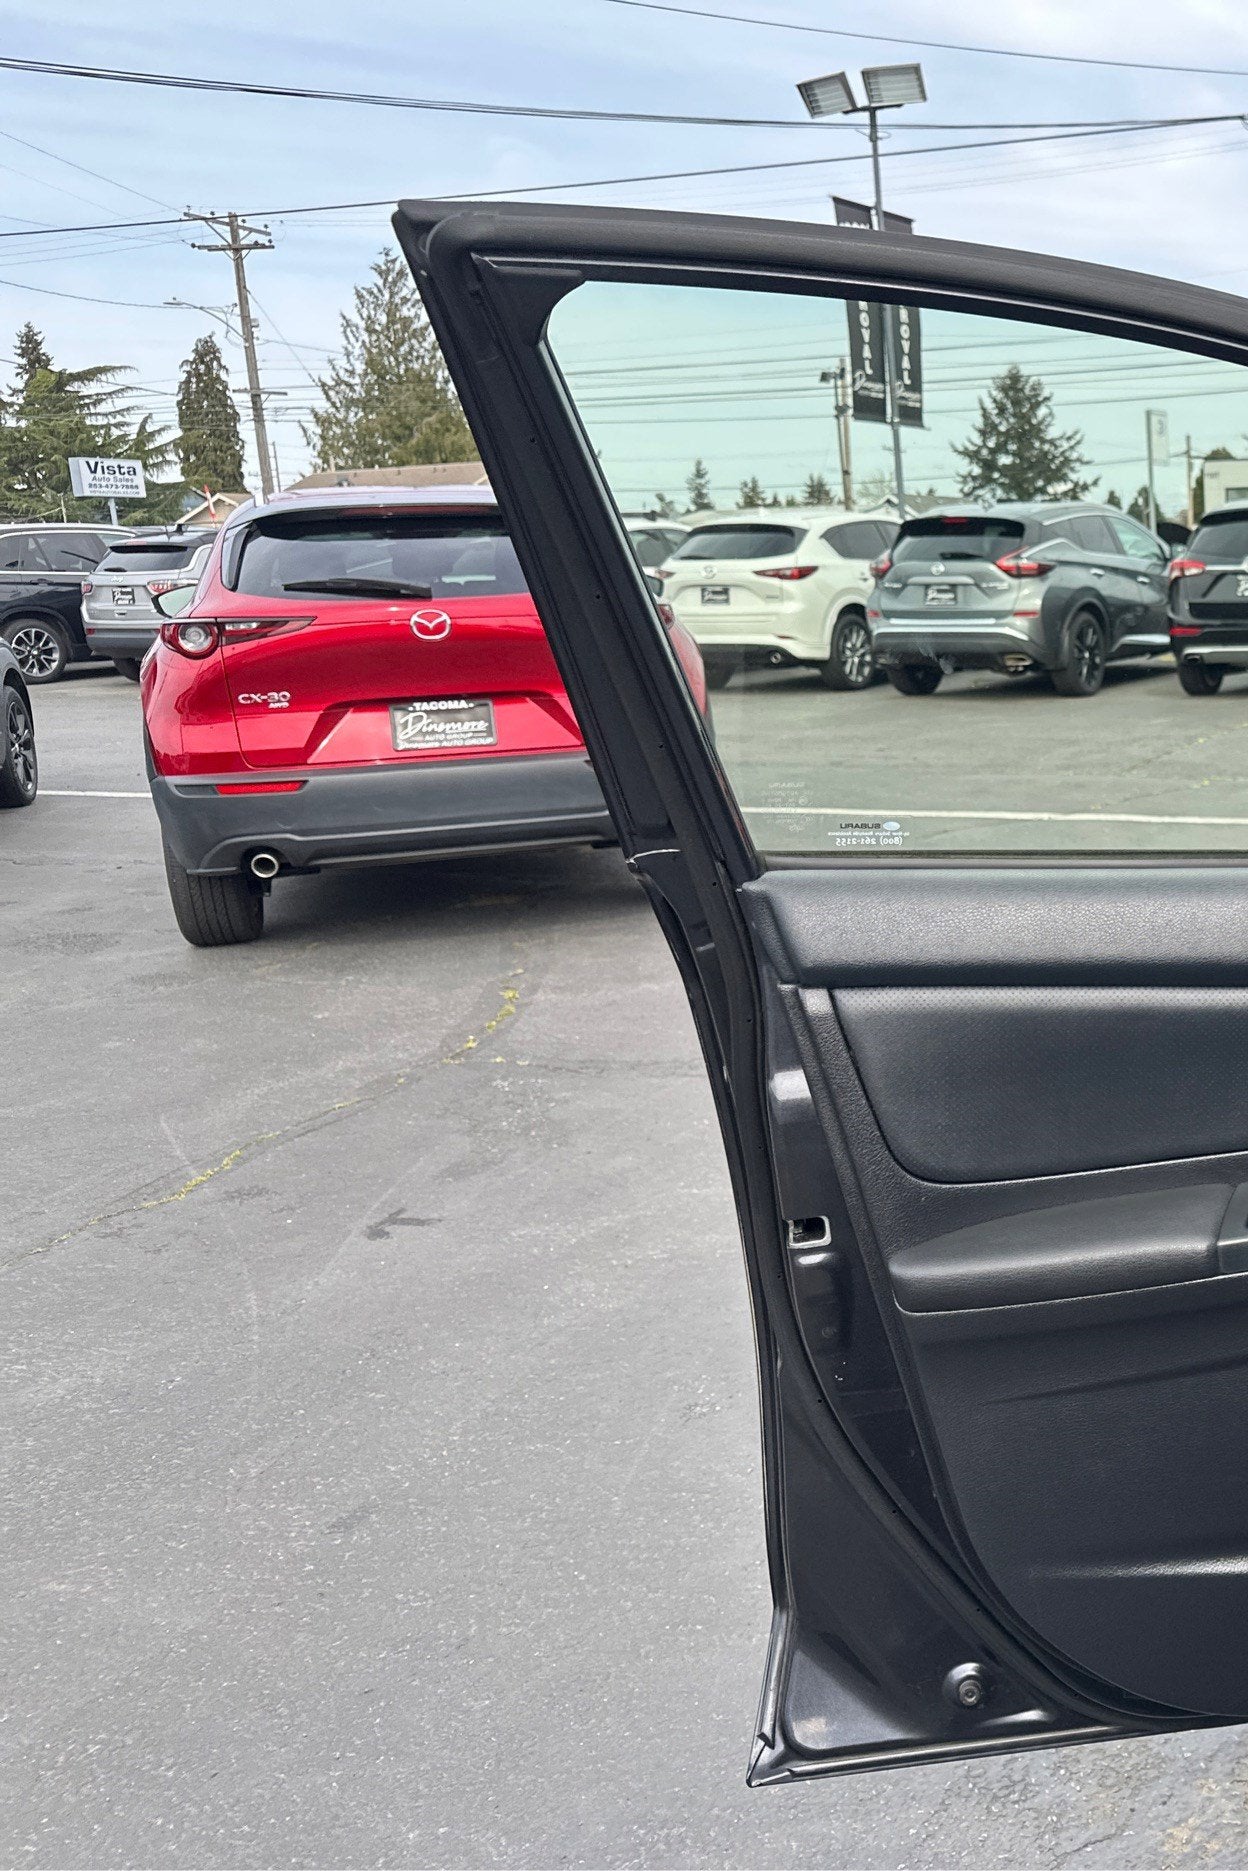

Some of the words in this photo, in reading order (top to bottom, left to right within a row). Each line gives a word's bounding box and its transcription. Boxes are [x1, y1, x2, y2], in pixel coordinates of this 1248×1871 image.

[85, 460, 137, 476] Vista
[112, 476, 135, 484] Sales
[238, 691, 291, 704] CX-30
[412, 700, 469, 711] TACOMA
[424, 733, 446, 741] AUTO
[446, 731, 474, 740] GROUP
